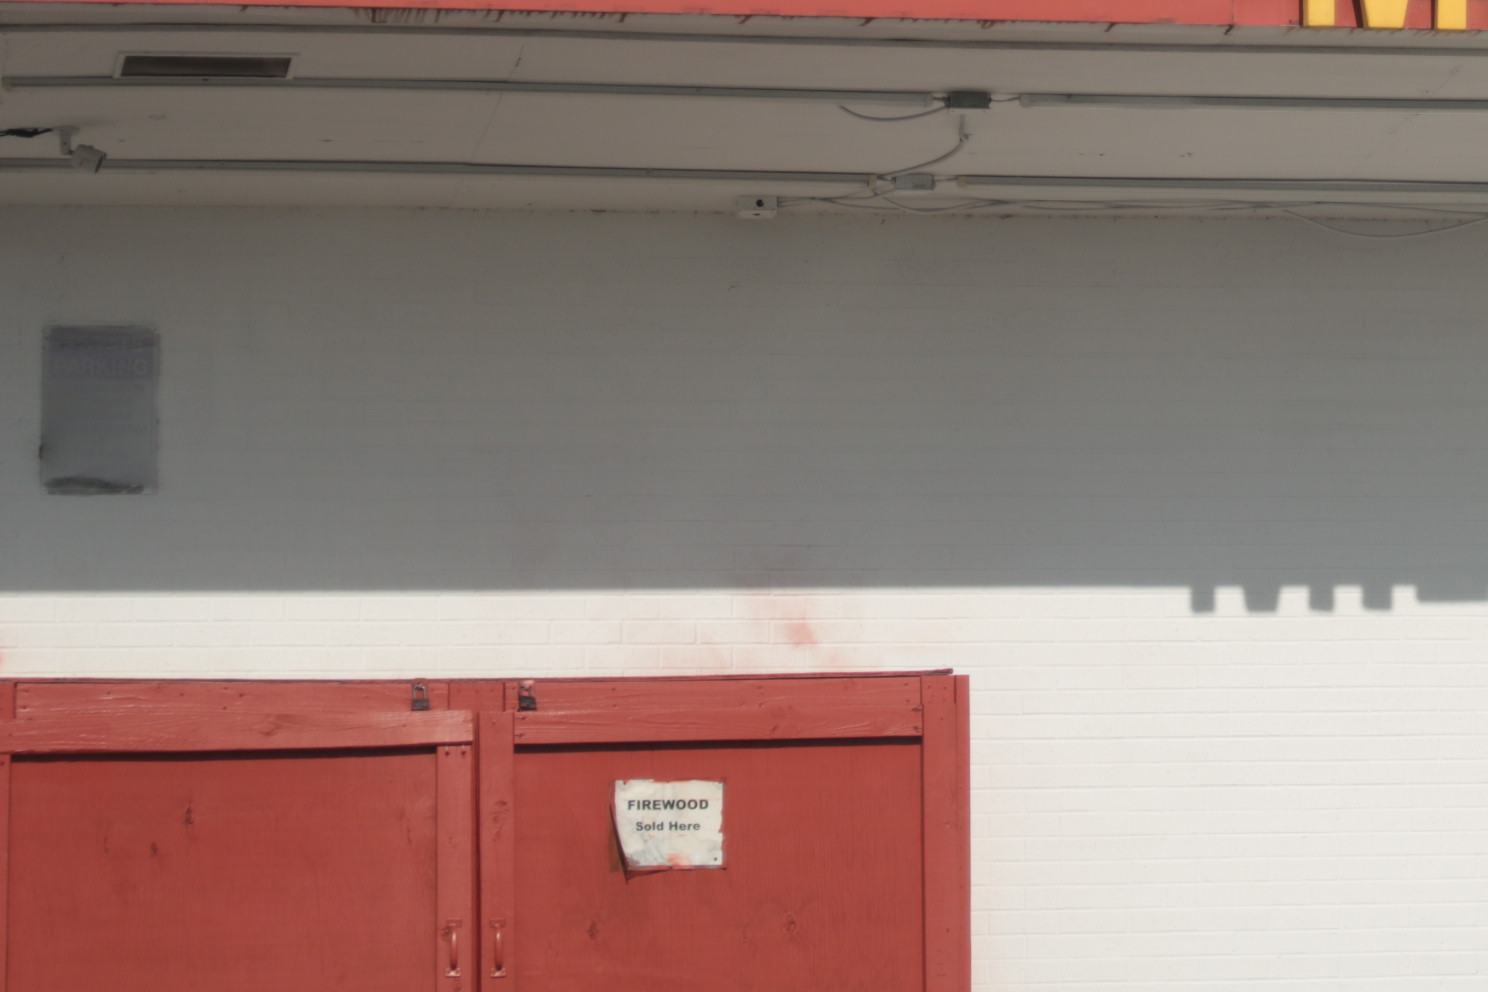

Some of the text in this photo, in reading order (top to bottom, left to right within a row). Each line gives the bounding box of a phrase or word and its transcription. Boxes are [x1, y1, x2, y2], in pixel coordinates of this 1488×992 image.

[627, 799, 709, 810] FIREWOOD
[636, 821, 701, 831] Sold Here
